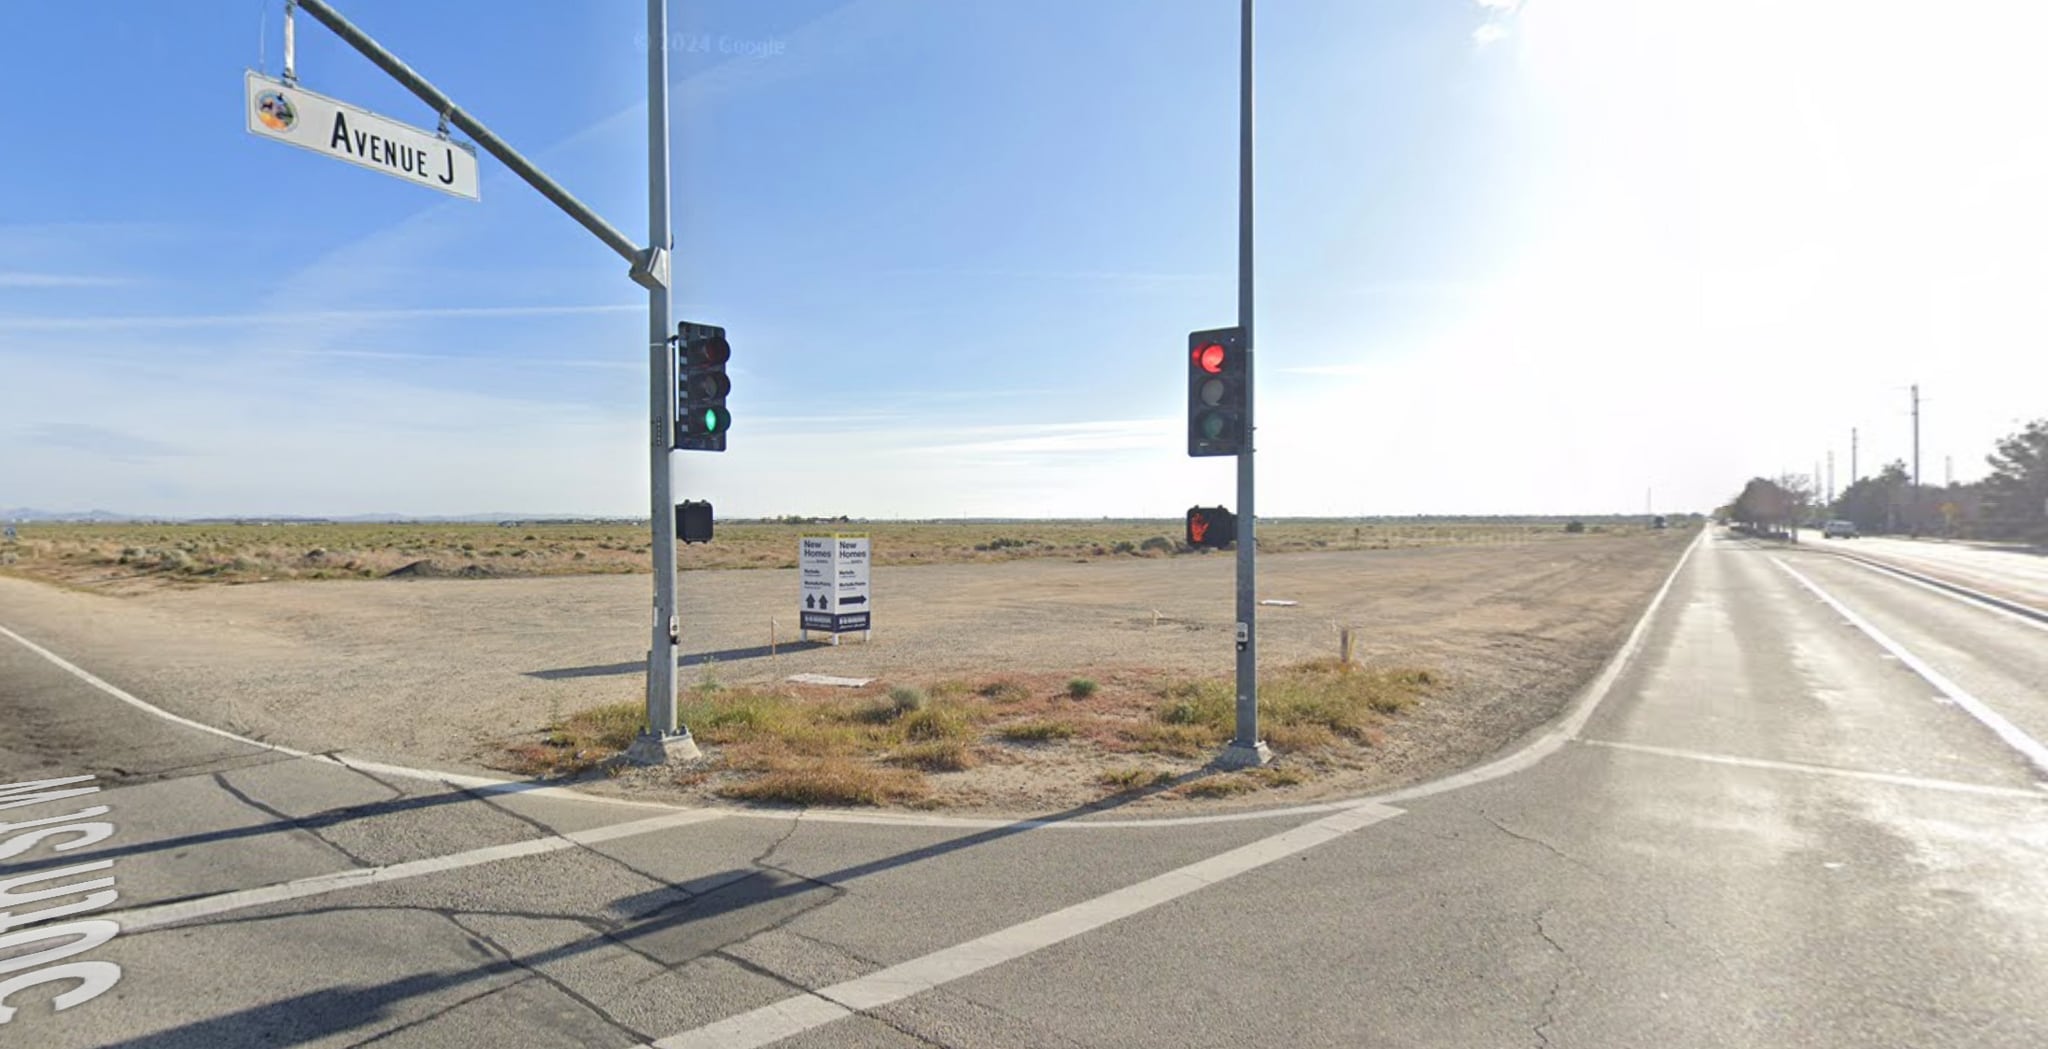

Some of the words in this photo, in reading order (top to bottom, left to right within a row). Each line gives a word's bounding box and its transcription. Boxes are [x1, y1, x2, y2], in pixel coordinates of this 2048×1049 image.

[438, 148, 455, 185] J
[804, 540, 821, 549] New
[839, 541, 857, 550] New
[804, 549, 832, 558] Homes
[839, 550, 867, 559] Homes
